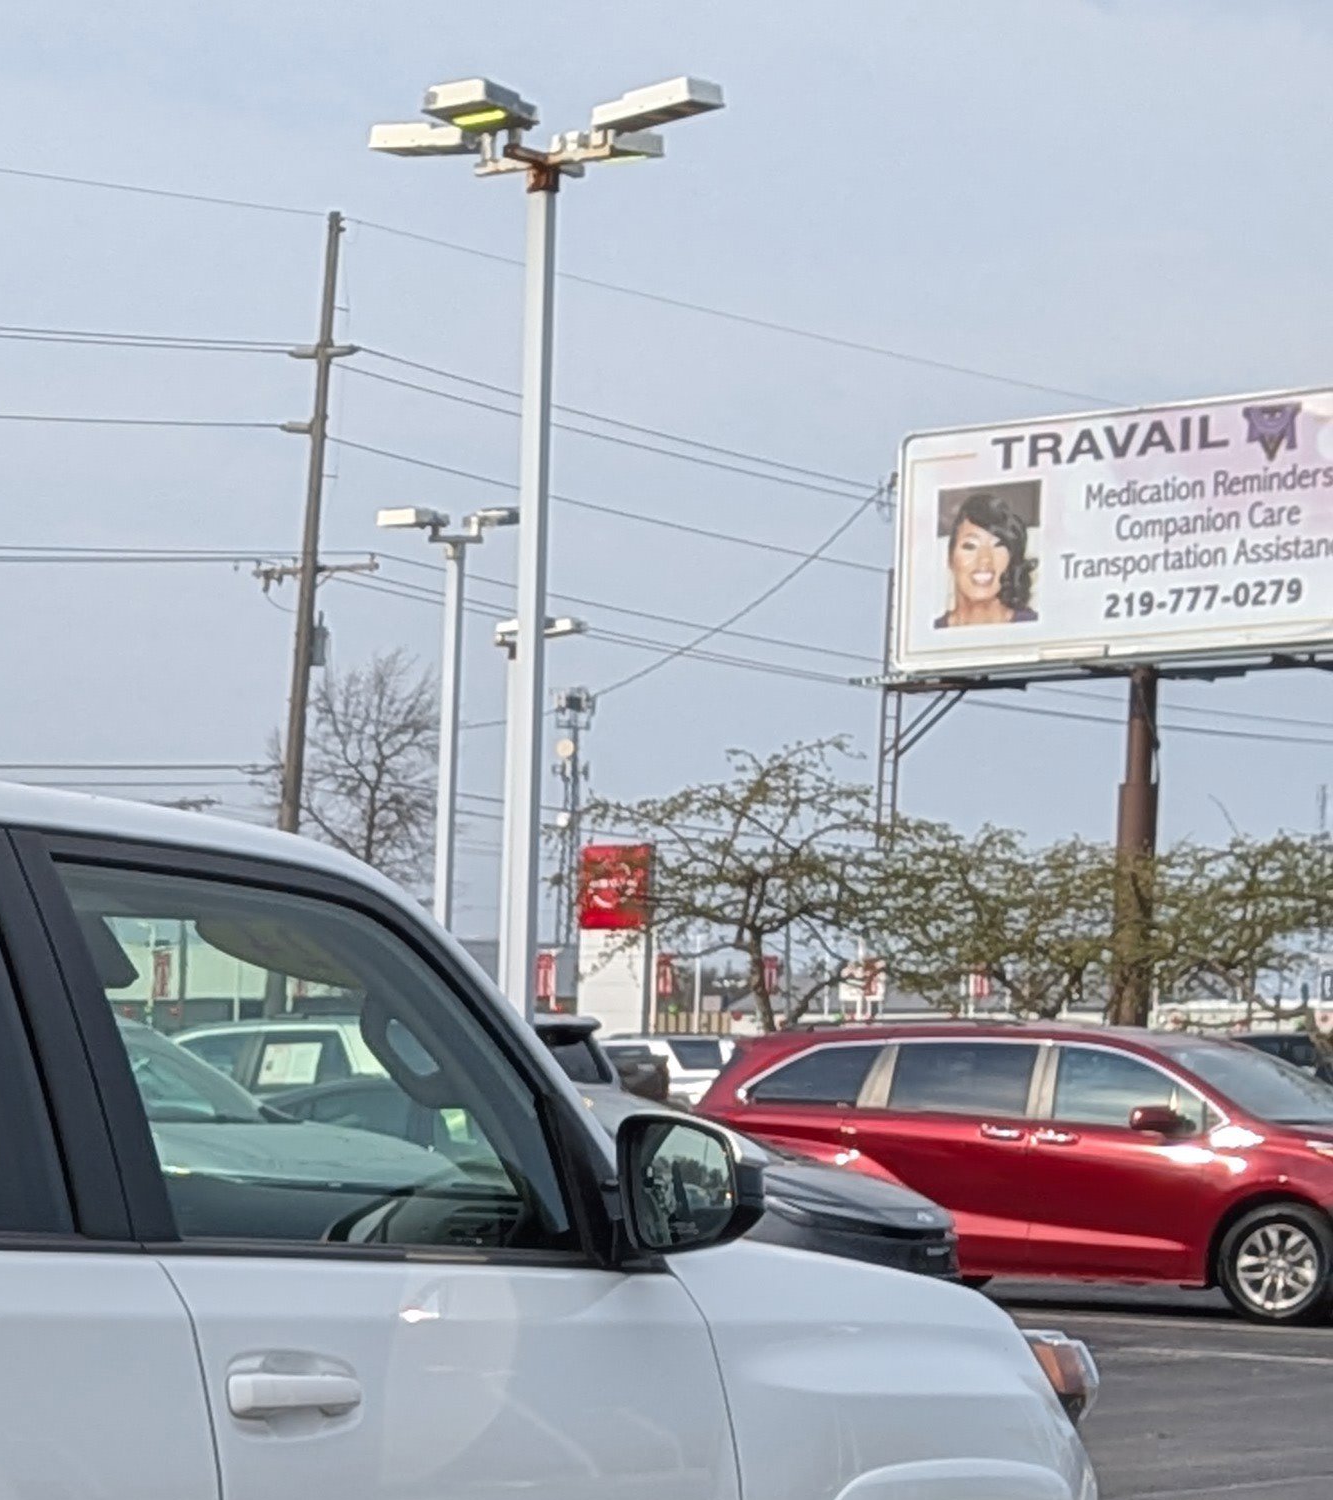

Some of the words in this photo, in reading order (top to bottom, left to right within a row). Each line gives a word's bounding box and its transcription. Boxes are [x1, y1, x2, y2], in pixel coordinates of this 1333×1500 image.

[991, 415, 1229, 470] TRAVAIL
[1085, 472, 1205, 511] Medication
[1213, 463, 1333, 498] Reminders
[1115, 506, 1240, 544] Companion
[1247, 500, 1302, 529] Care
[1061, 541, 1227, 582] Transportation
[1232, 534, 1333, 565] Assistan
[1103, 577, 1303, 619] 219-777-0279
